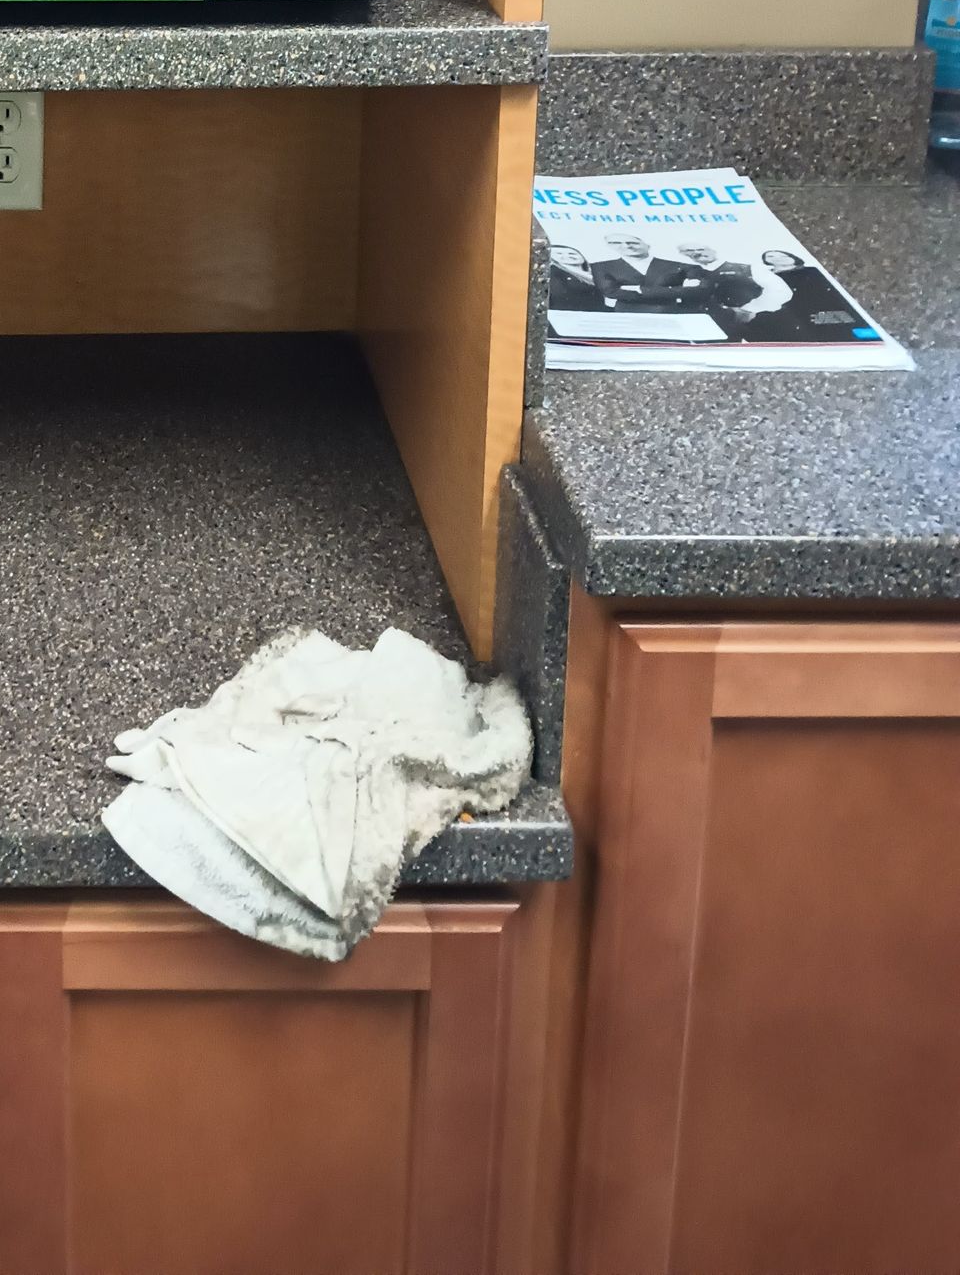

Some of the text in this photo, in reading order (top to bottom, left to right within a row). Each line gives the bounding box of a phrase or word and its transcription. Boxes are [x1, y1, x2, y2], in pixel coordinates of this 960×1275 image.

[616, 184, 756, 207] PEOPLE
[580, 212, 636, 223] WHAT
[644, 213, 739, 224] MATTERS
